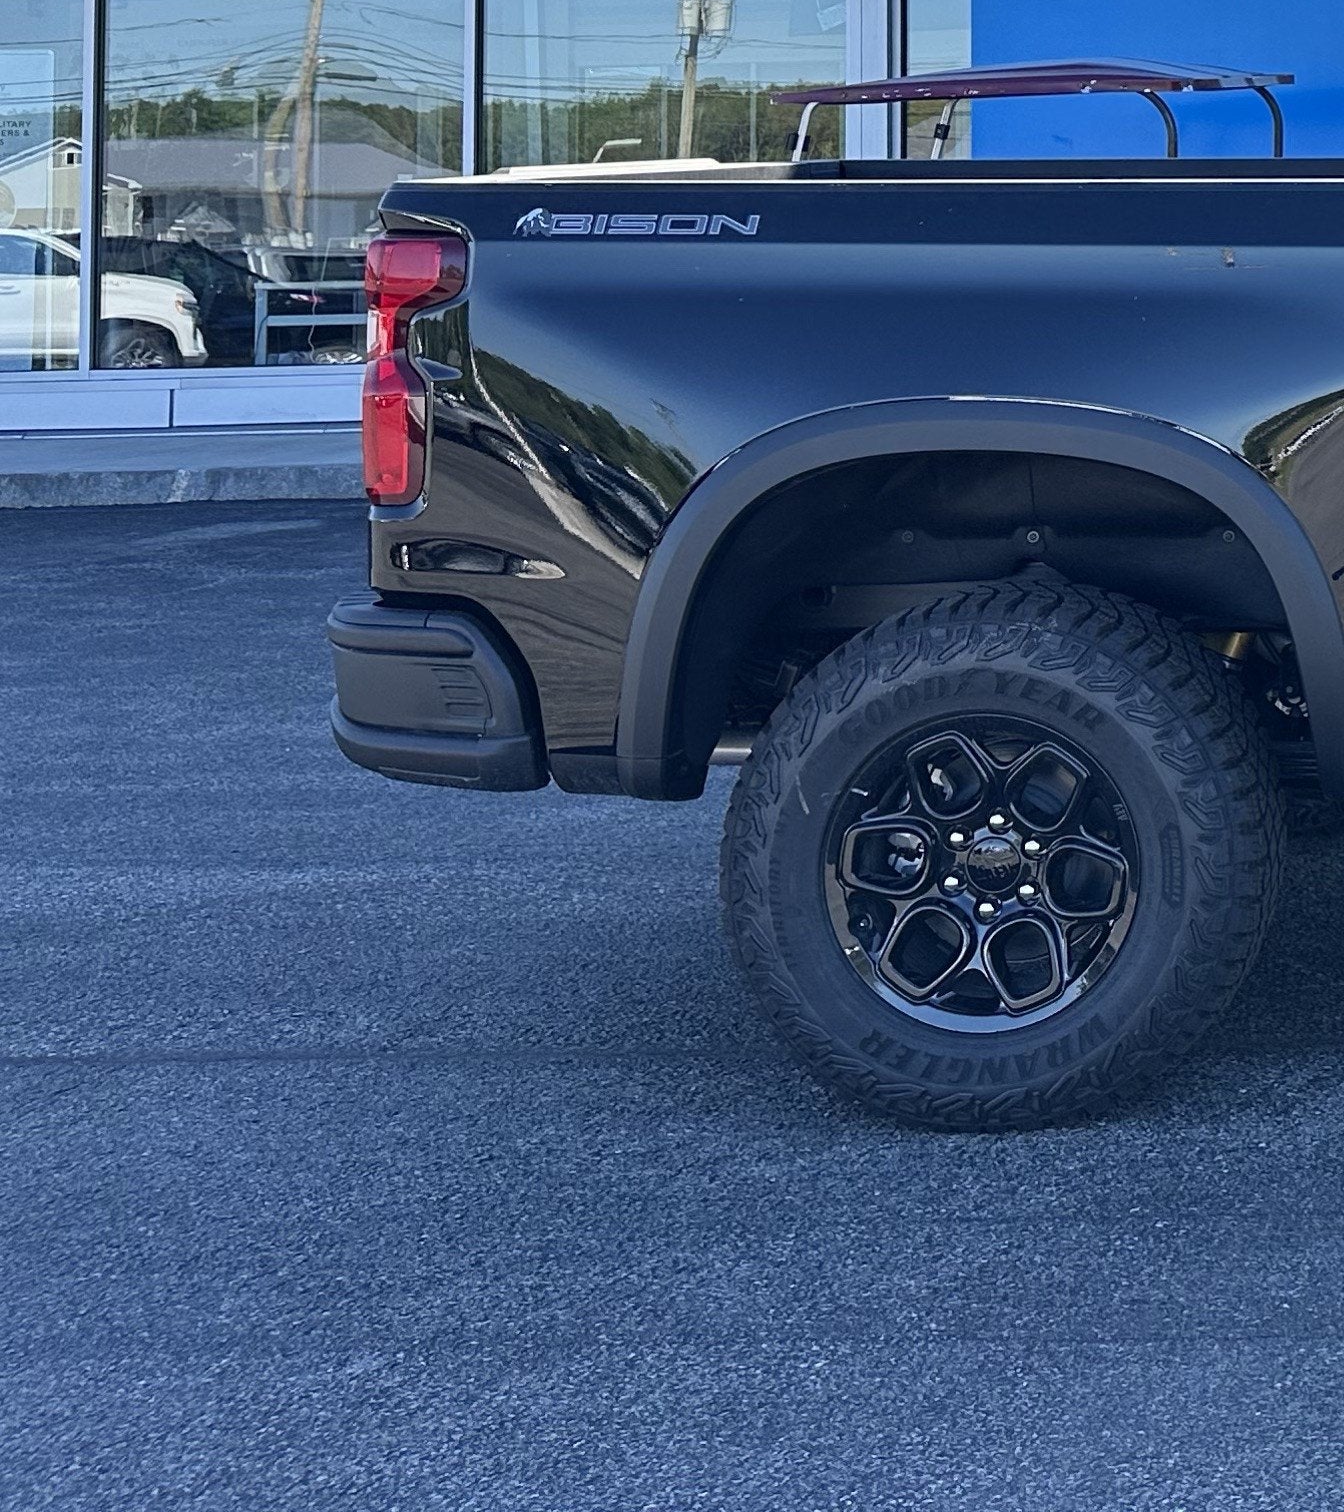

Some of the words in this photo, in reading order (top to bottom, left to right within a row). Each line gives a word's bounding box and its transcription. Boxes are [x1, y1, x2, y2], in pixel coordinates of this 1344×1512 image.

[0, 120, 31, 128] ITARY
[549, 214, 760, 235] BISON
[836, 668, 1106, 747] GOODYEAR
[857, 1017, 1116, 1086] WRANGLER
